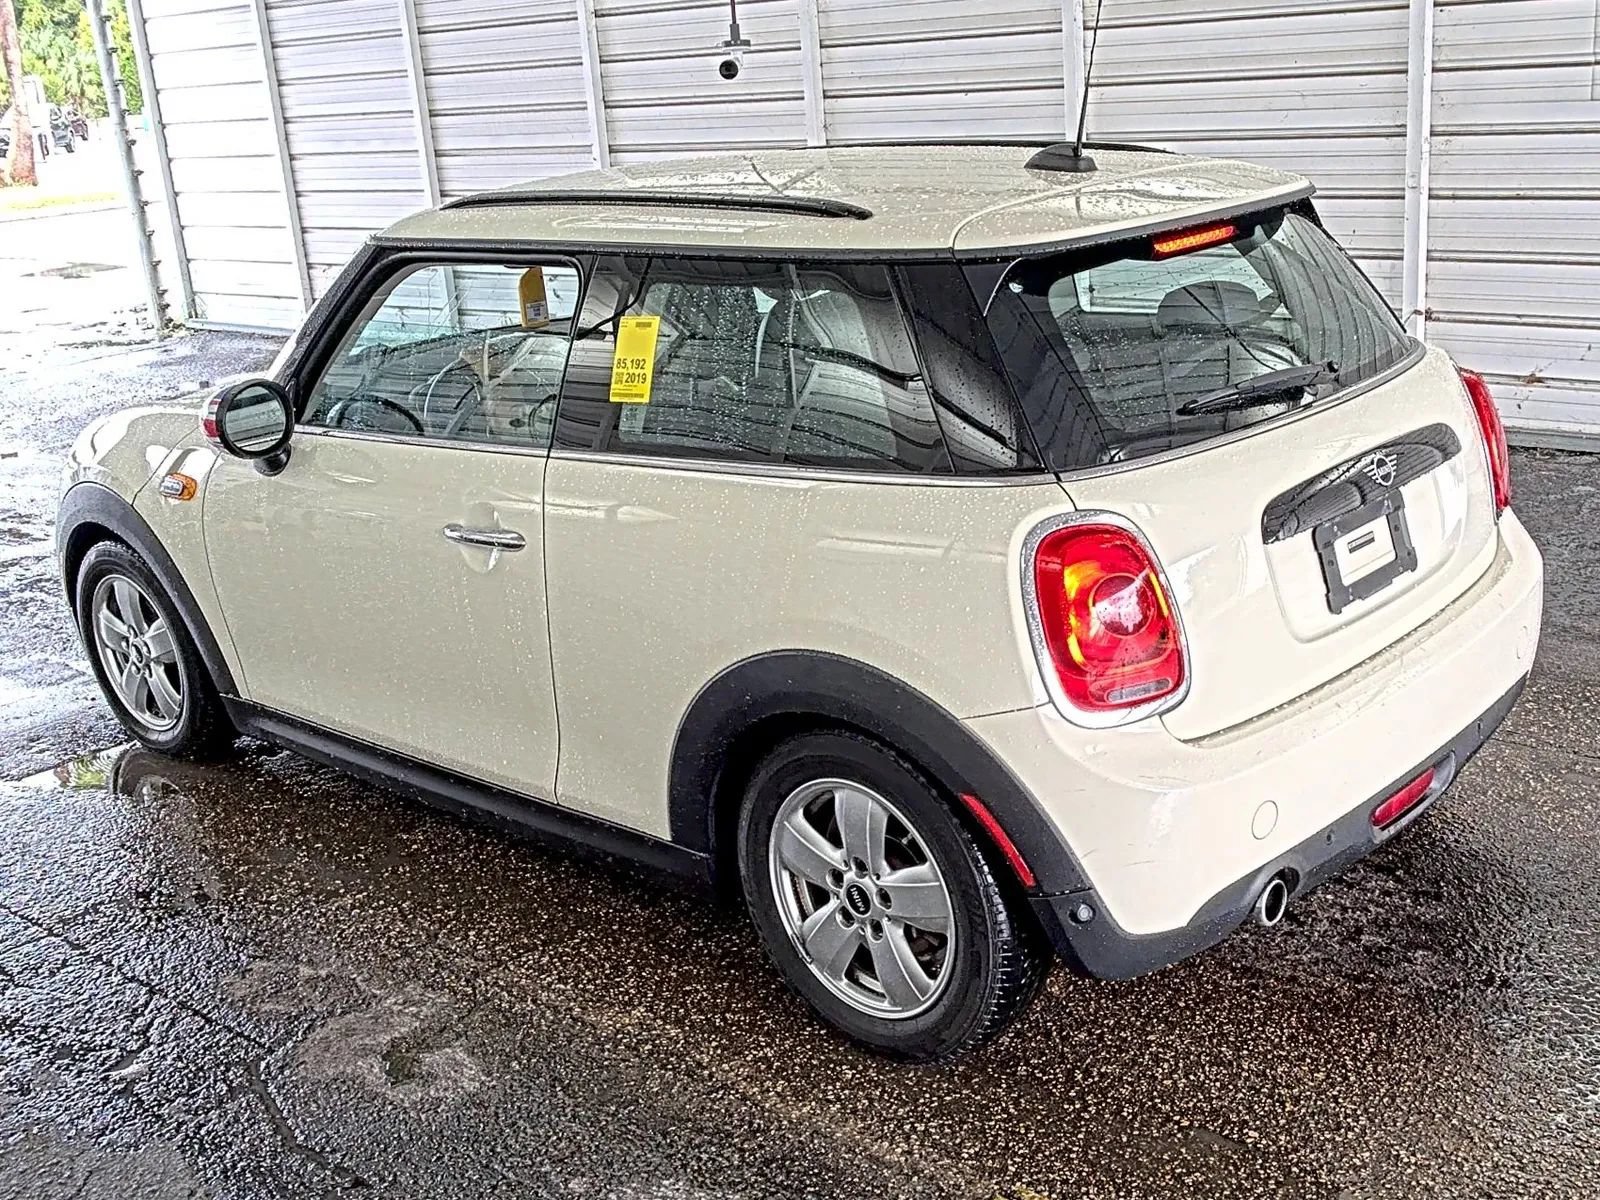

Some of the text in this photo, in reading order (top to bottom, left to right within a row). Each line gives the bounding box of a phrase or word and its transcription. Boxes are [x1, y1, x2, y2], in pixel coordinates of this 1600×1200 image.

[616, 358, 646, 371] 85,192
[625, 372, 647, 385] 2019
[850, 887, 866, 911] MINI
